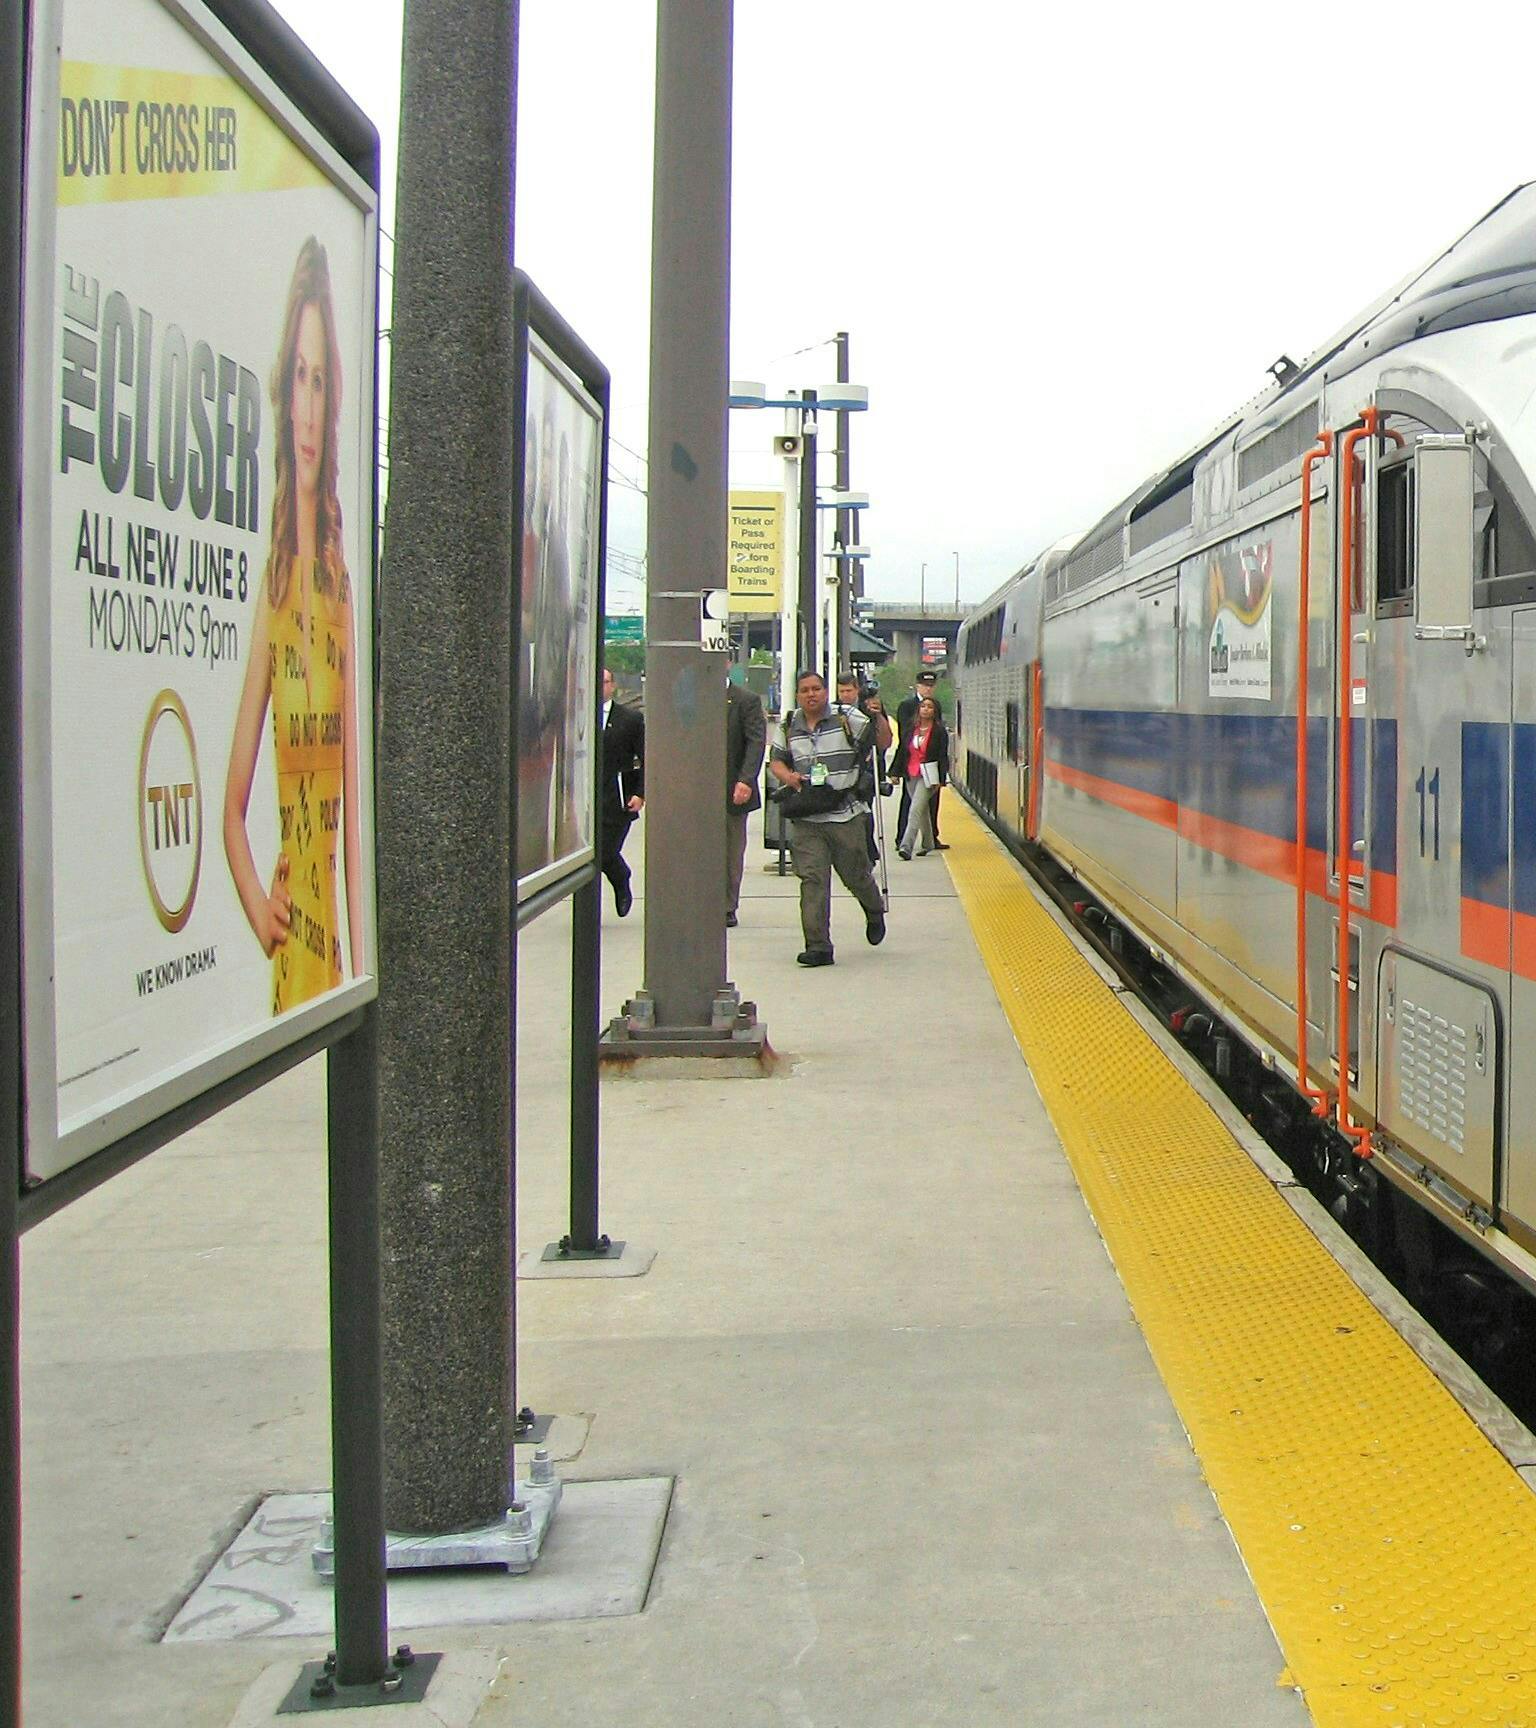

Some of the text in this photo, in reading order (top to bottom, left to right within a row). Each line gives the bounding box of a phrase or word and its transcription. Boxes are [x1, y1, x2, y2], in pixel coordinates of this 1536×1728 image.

[61, 97, 237, 177] DON'T CROSS HER
[61, 263, 99, 475] THE
[99, 289, 262, 534] CLOSER
[730, 540, 776, 551] Required
[731, 516, 774, 526] Ticket or
[741, 528, 765, 538] Pass
[75, 508, 248, 603] ALL NEW JUNE 8
[730, 564, 776, 576] Boarding
[737, 576, 768, 586] Trains
[89, 585, 197, 658] MONDAYS
[201, 603, 239, 671] 9pm
[147, 782, 194, 850] TNT
[1415, 765, 1440, 862] 11
[136, 945, 217, 998] WE KNOW DRAMA
